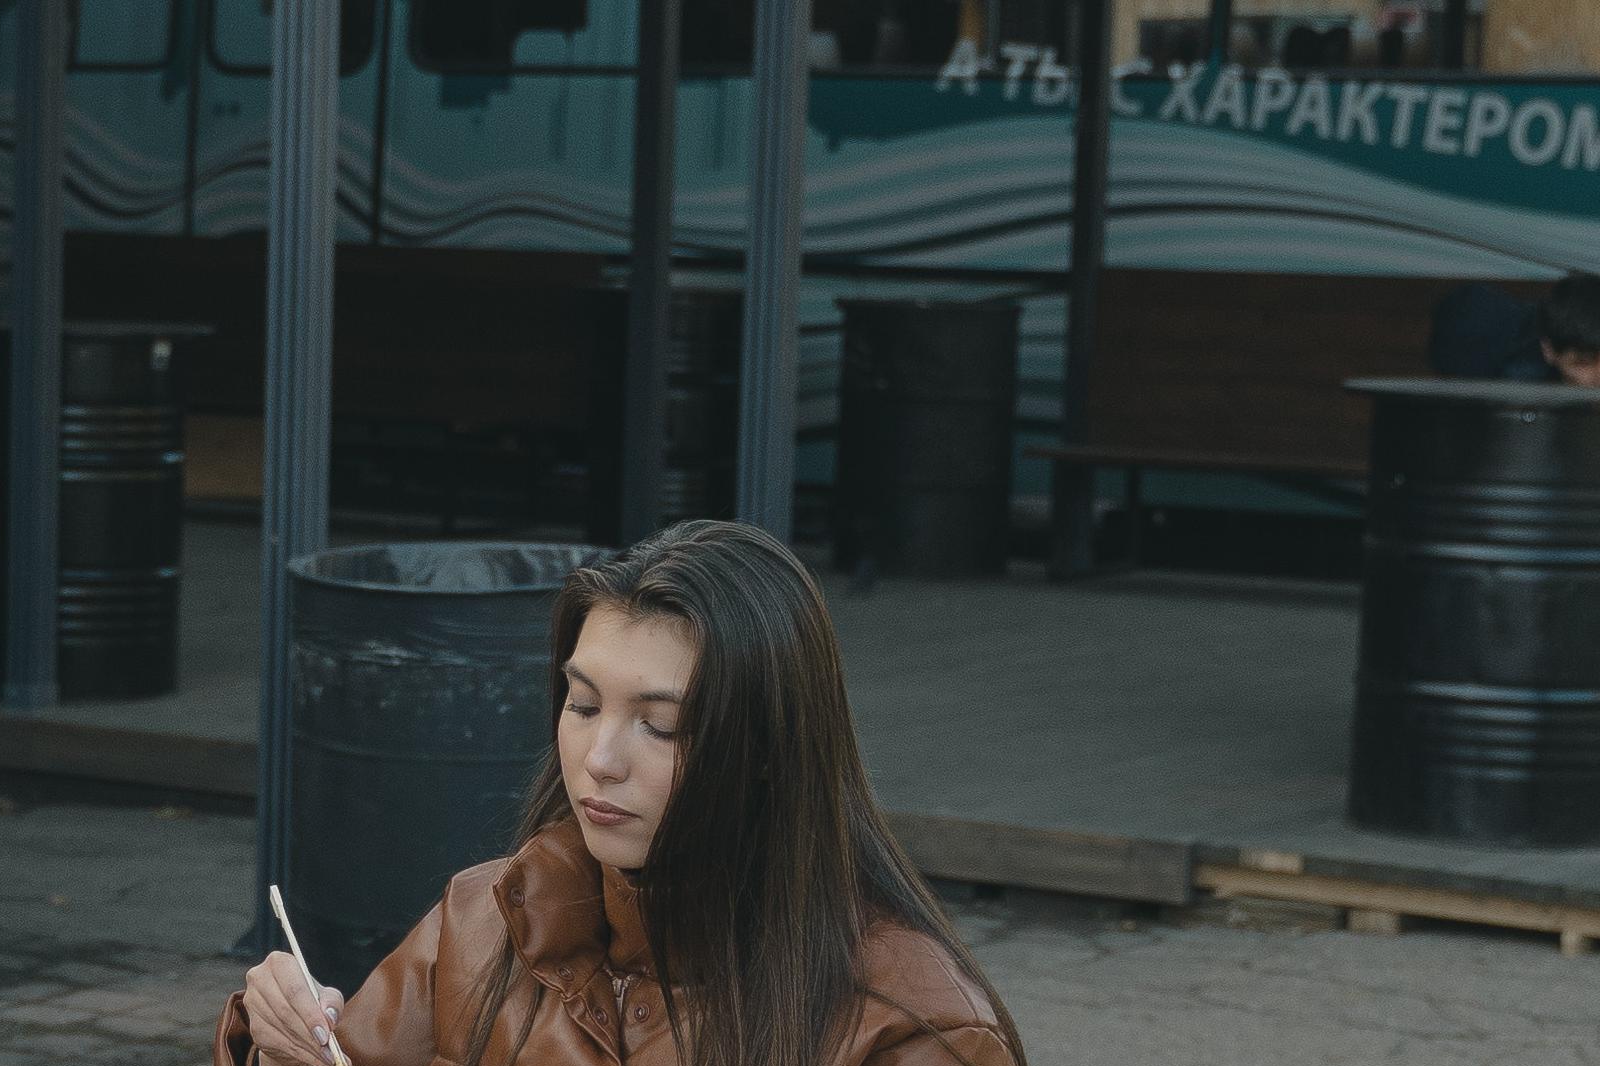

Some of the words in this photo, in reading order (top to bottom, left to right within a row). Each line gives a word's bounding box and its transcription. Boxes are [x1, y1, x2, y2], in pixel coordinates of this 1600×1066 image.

[935, 37, 980, 96] А
[1108, 56, 1152, 116] С
[1160, 62, 1600, 171] ХАРАКТЕРОМ
